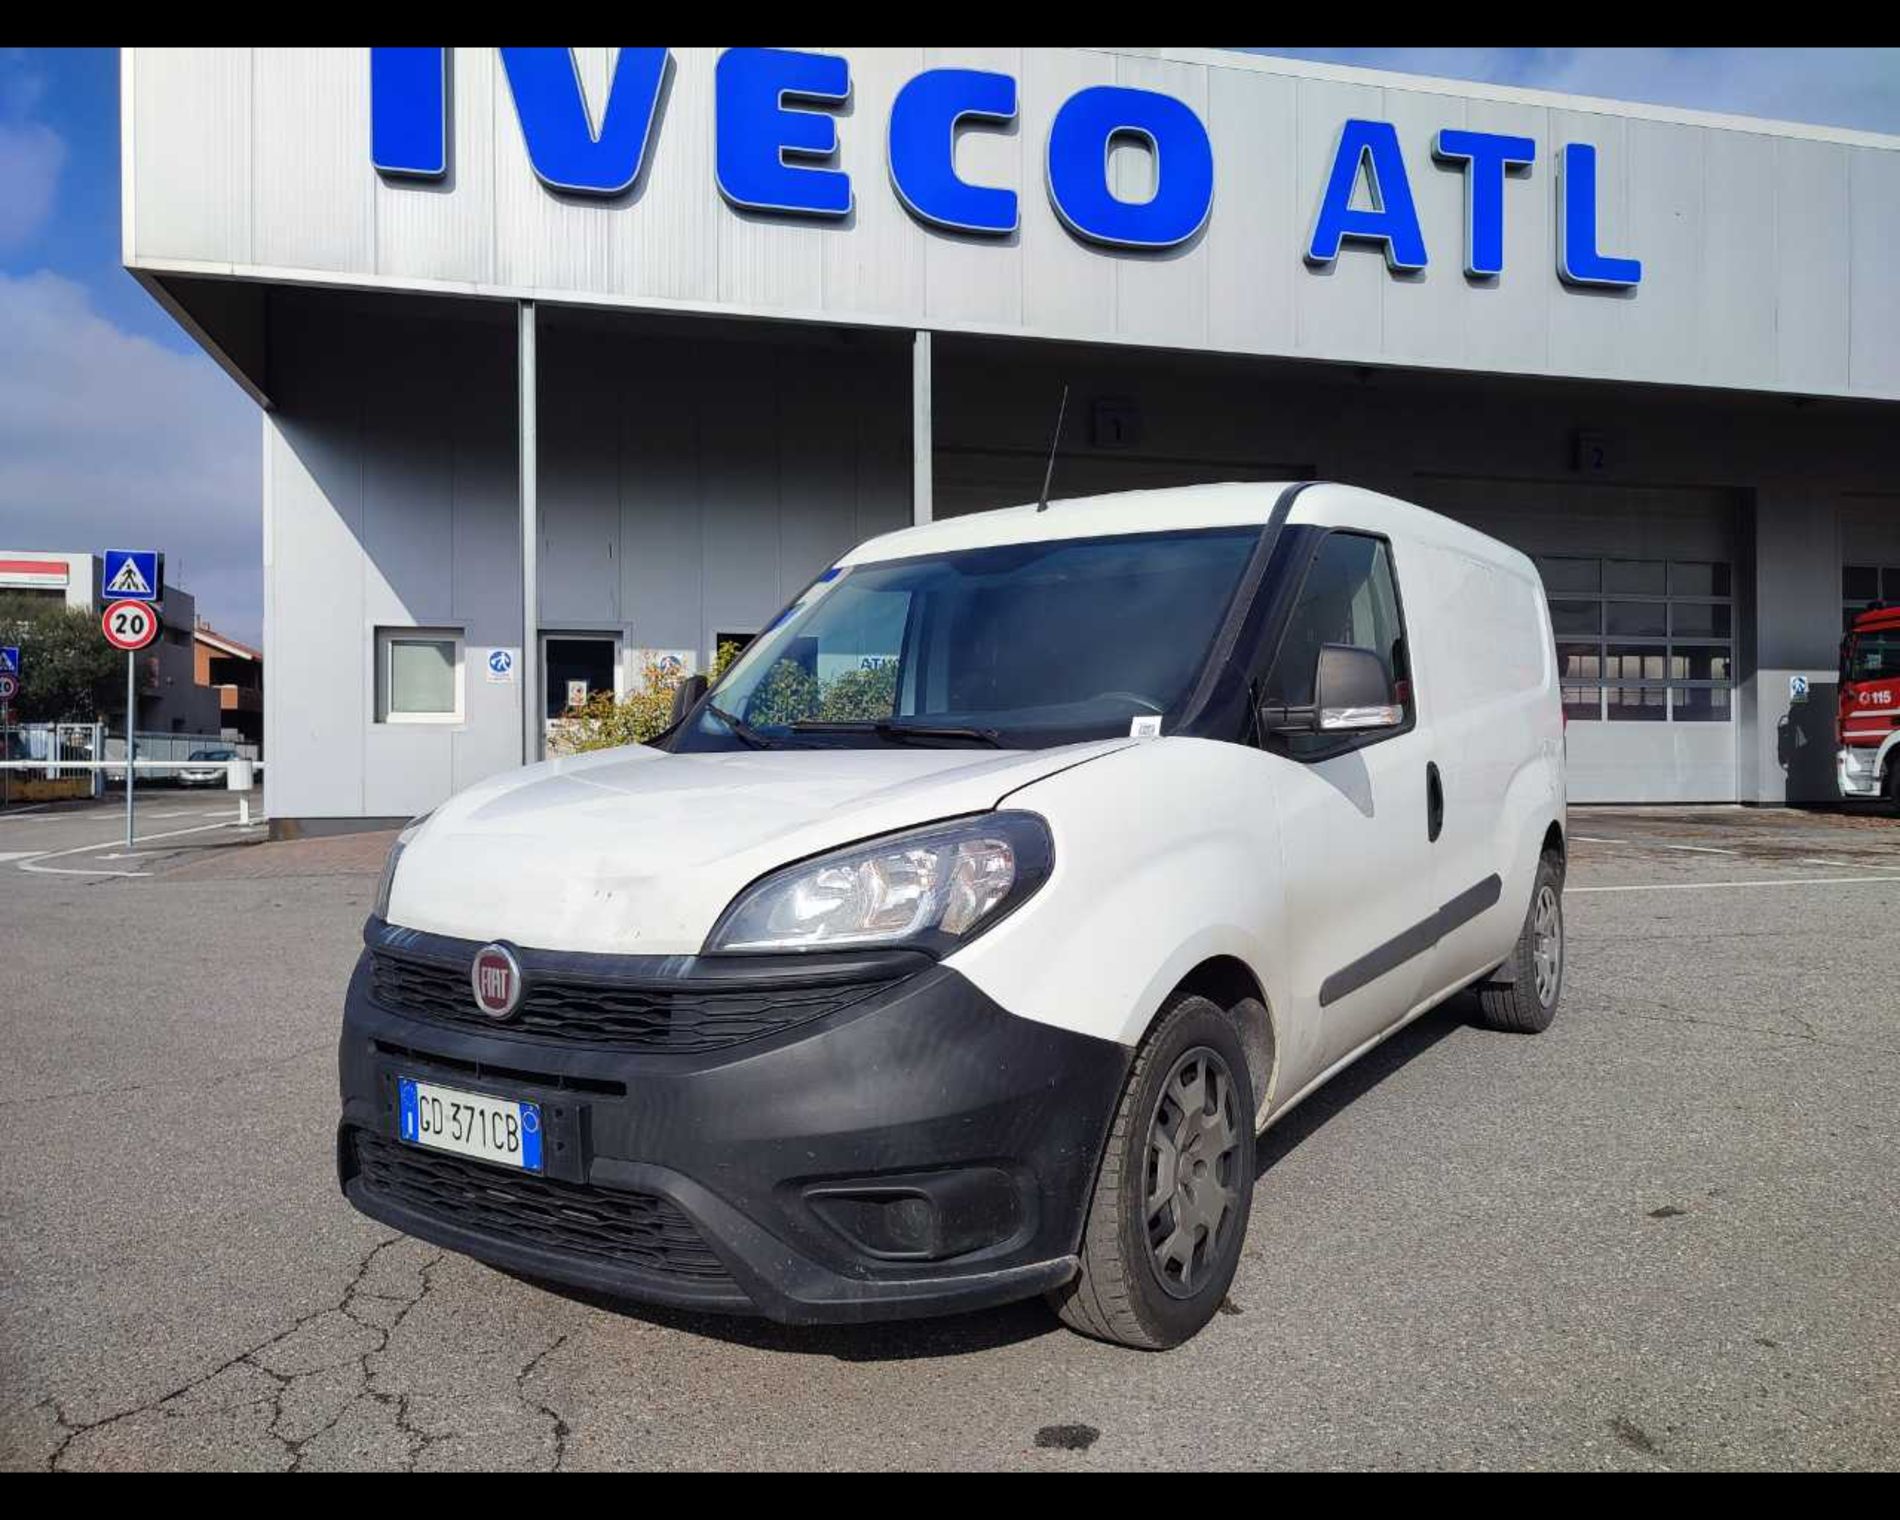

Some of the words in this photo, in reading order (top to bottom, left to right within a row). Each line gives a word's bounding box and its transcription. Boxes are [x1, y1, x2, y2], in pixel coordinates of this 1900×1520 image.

[370, 47, 1214, 248] IVECO
[1306, 118, 1642, 287] ATL
[115, 613, 144, 635] 20
[1872, 690, 1892, 705] 115
[481, 966, 509, 1000] FIAT
